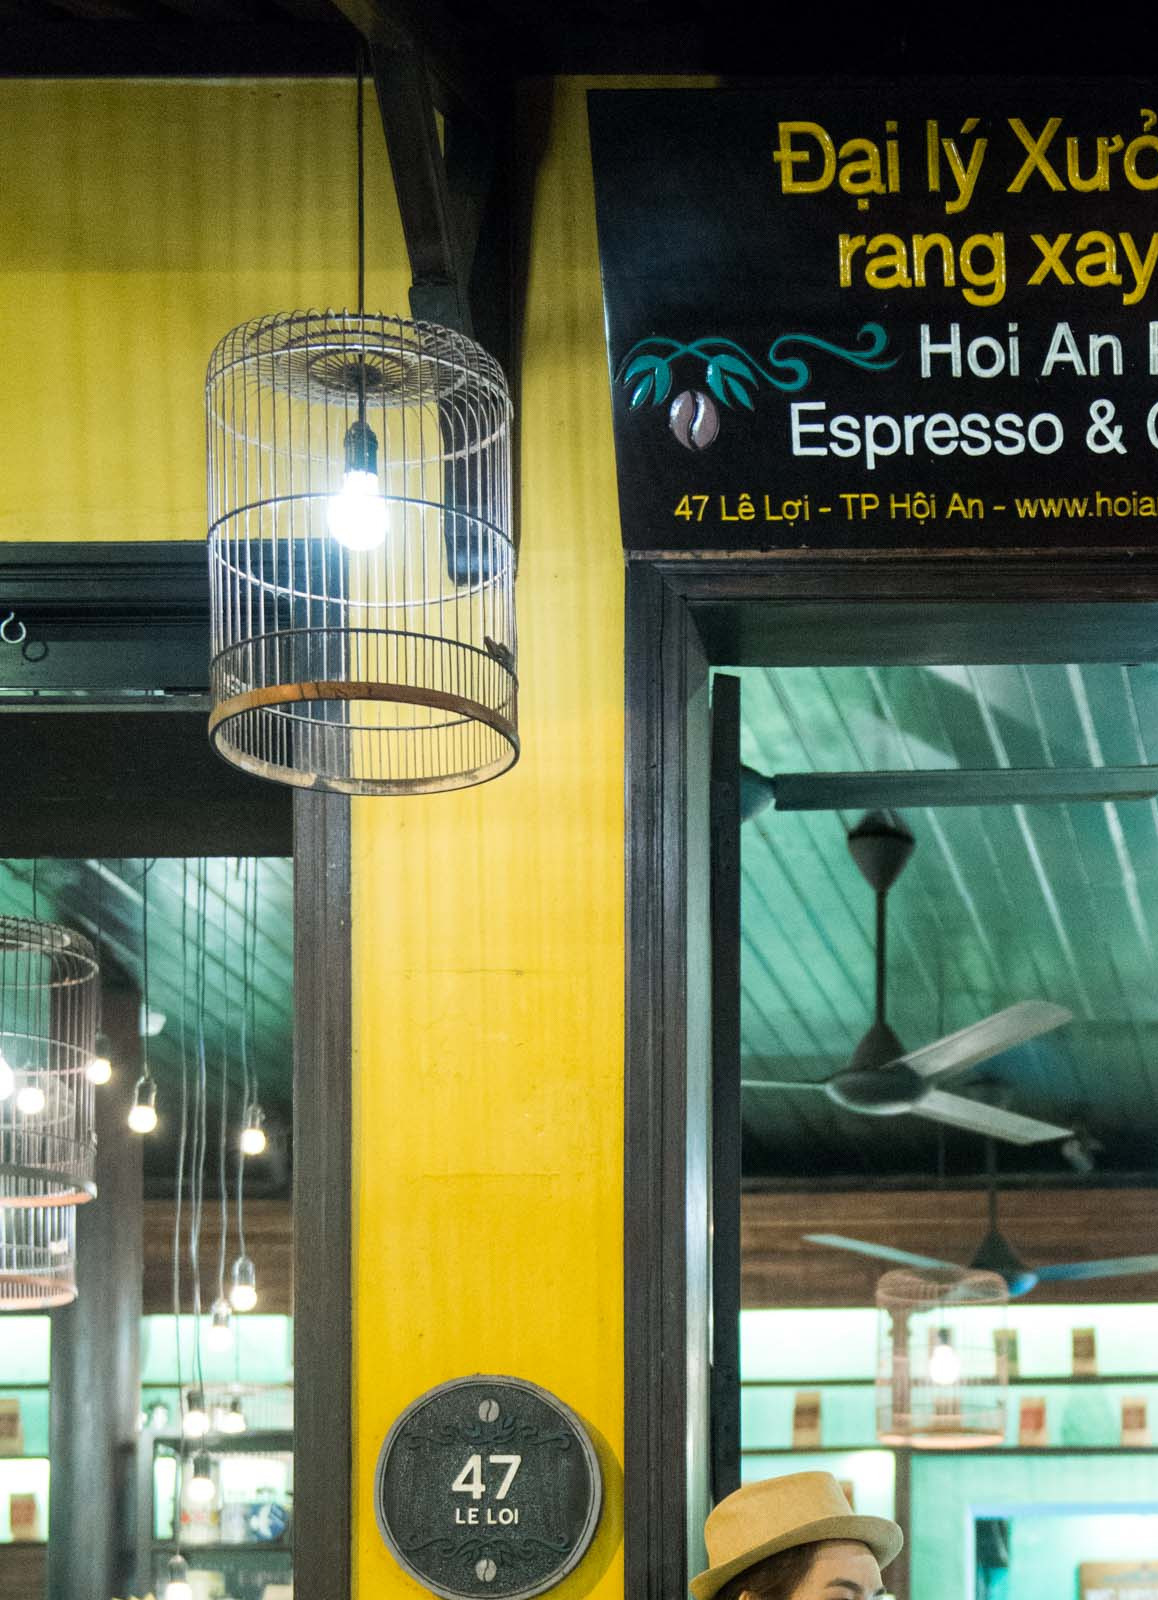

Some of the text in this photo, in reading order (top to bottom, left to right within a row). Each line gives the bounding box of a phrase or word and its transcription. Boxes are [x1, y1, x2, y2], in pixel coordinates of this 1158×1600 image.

[773, 121, 900, 210] Đại
[927, 118, 985, 215] lý
[838, 232, 1007, 306] rang
[920, 322, 1020, 379] Hoi
[1041, 321, 1124, 377] An
[790, 401, 1064, 471] Espresso
[1085, 398, 1128, 455] &
[674, 494, 710, 522] 47
[720, 493, 756, 521] Lê
[764, 494, 810, 527] Lợi
[839, 493, 880, 520] TP
[890, 491, 936, 525] Hội
[945, 492, 984, 519] An
[451, 1454, 522, 1500] 47
[455, 1507, 519, 1525] LE LOI
